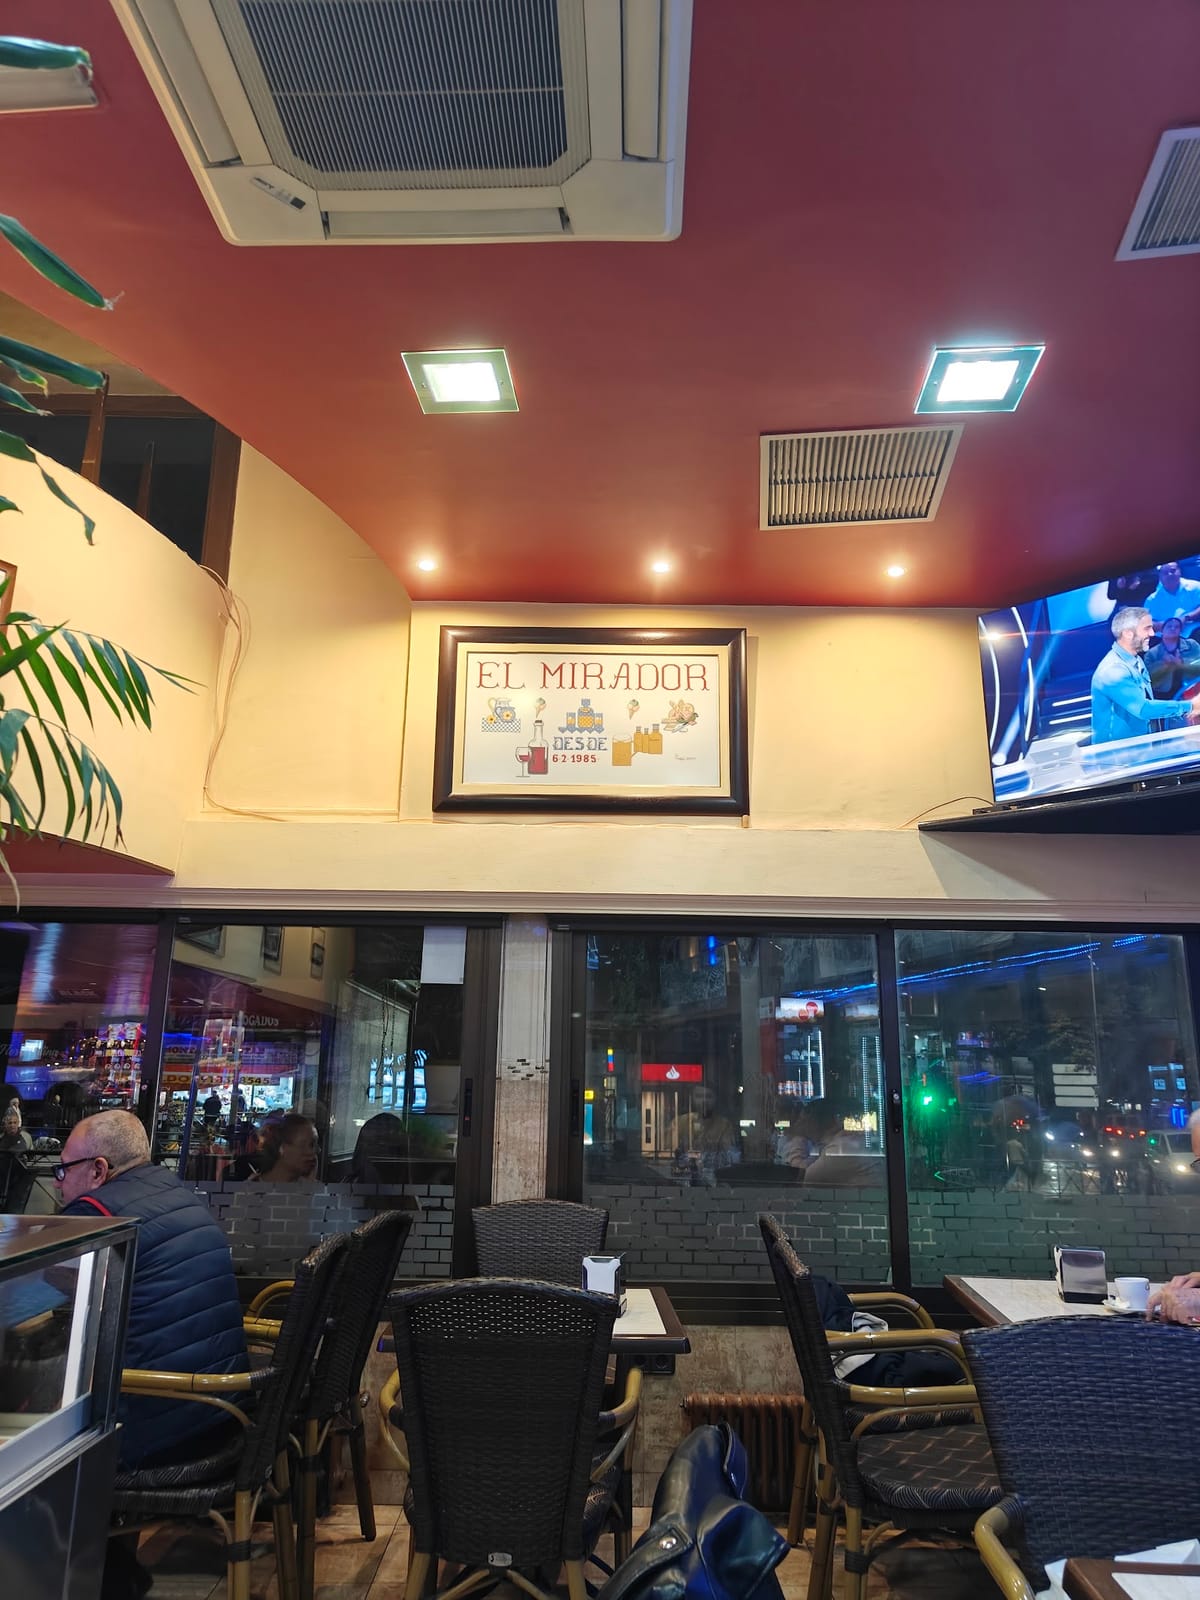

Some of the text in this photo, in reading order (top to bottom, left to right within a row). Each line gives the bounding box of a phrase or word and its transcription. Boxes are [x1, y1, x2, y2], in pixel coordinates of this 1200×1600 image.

[476, 661, 710, 691] EL MIRADOR
[552, 736, 608, 751] DESDE
[552, 753, 597, 763] 6 2 1985
